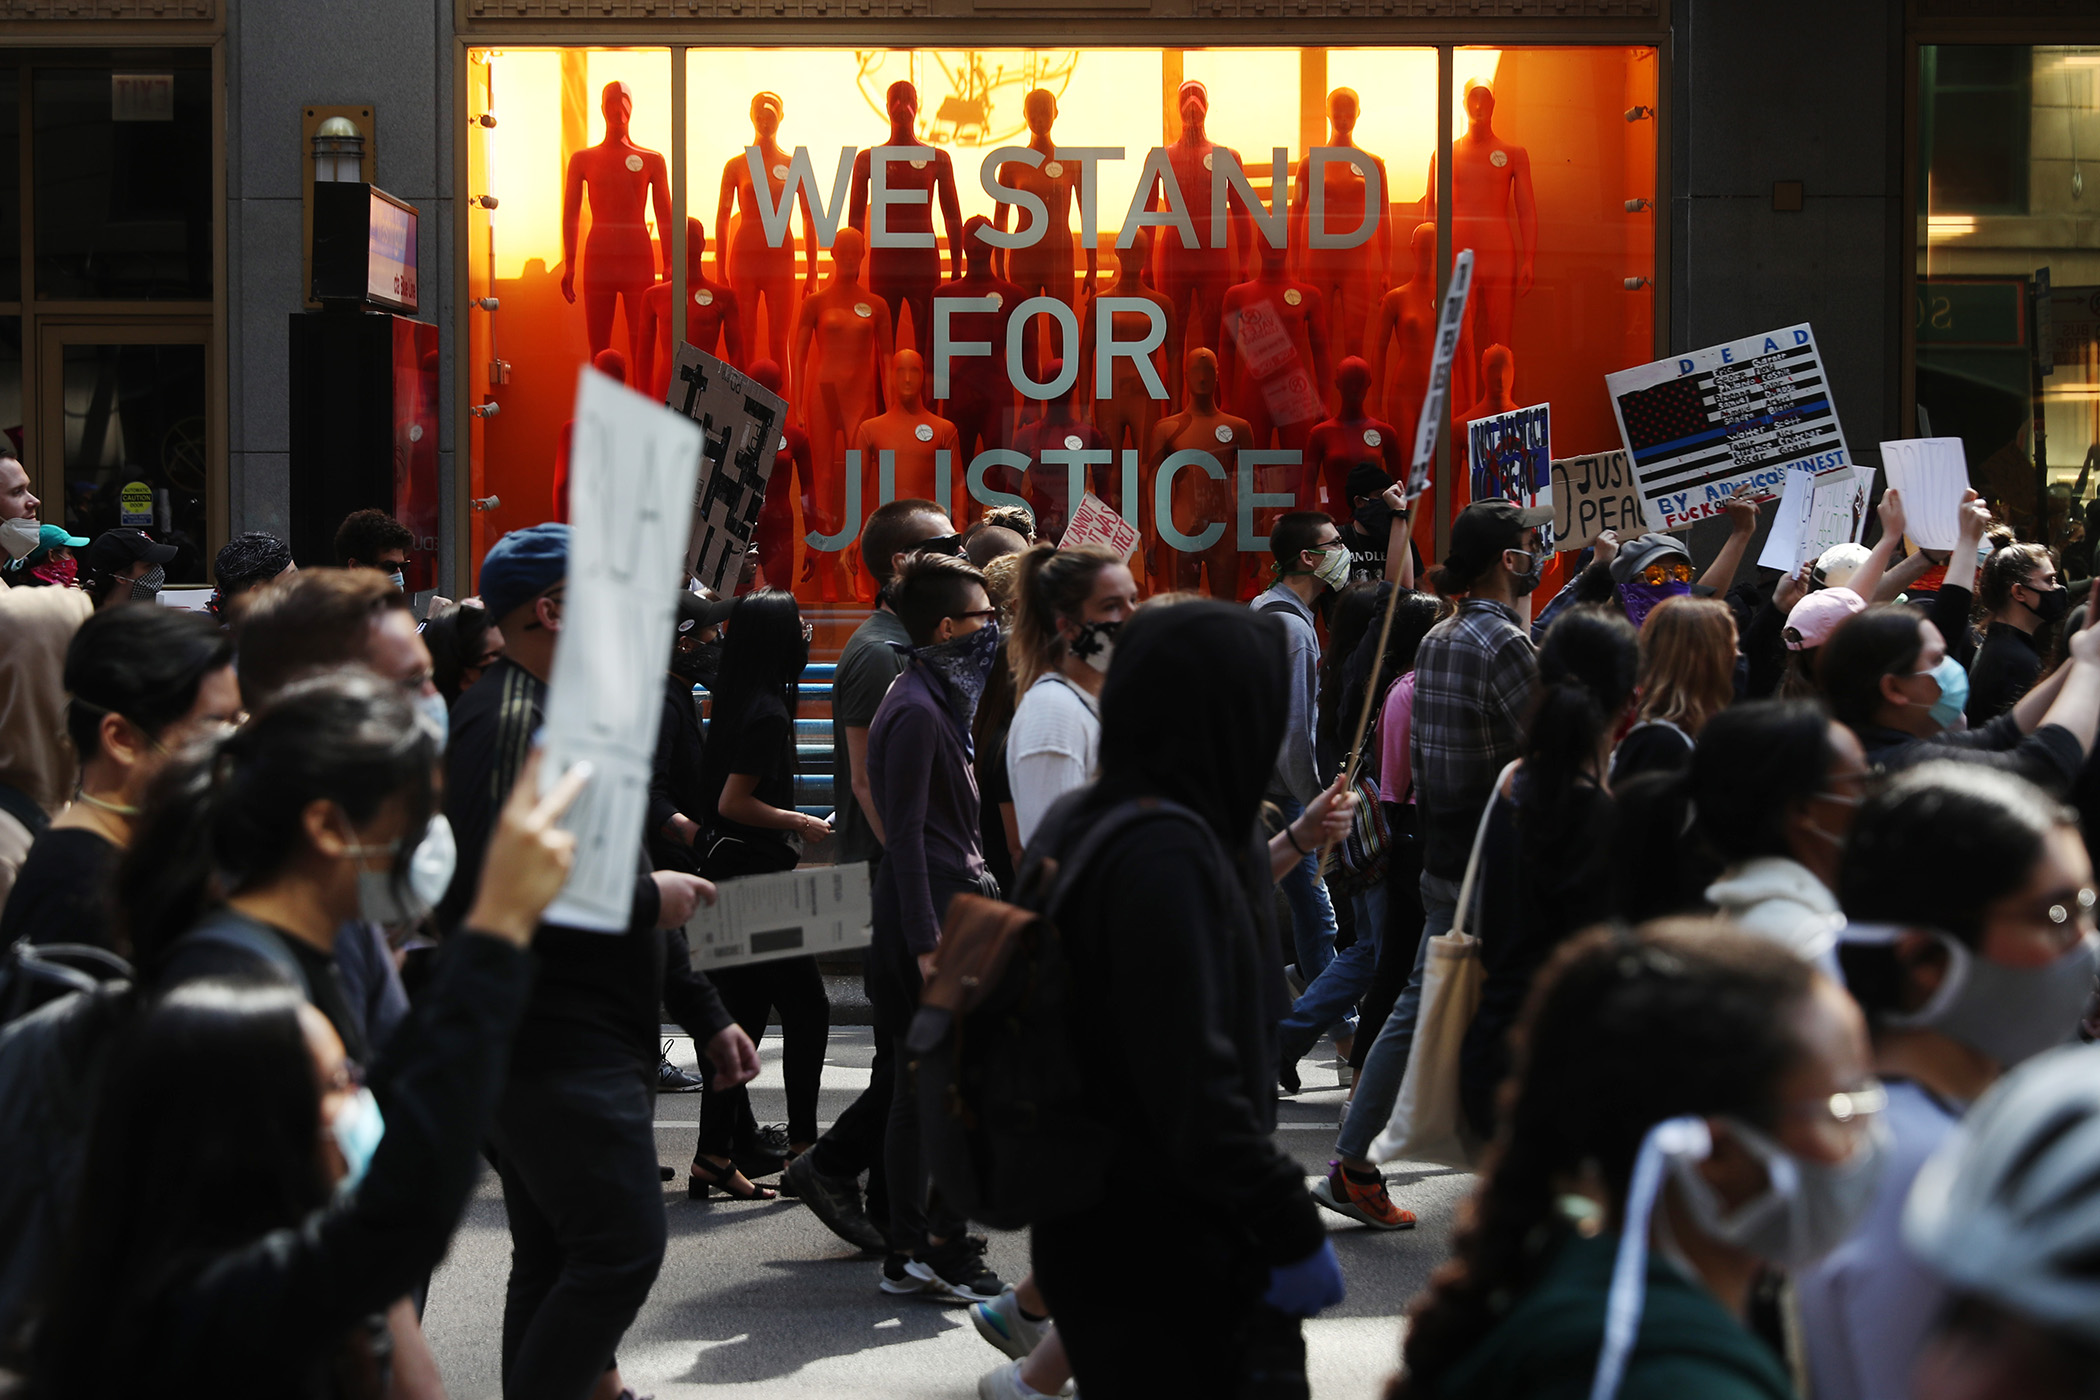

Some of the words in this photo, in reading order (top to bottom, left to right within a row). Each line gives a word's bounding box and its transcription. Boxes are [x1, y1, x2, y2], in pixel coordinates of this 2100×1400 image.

[745, 146, 935, 248] WE
[974, 146, 1381, 249] STAND
[933, 297, 1169, 400] FOR
[1679, 330, 1808, 375] DEAD
[1712, 366, 1733, 377] Eric
[1713, 371, 1748, 386] George
[1718, 396, 1750, 409] Samuel
[1724, 413, 1754, 425] Sandra
[1767, 402, 1795, 415] Bland
[1497, 407, 1549, 455] JUSTICE
[1727, 426, 1765, 440] Walter
[1774, 416, 1801, 430] Scott
[1734, 452, 1766, 465] Oscar
[1779, 441, 1811, 455] Grant
[805, 449, 1303, 551] JUSTICE
[1657, 492, 1687, 515] BY
[1066, 498, 1097, 544] CANNOT
[1093, 506, 1119, 538] WAS
[1665, 503, 1716, 528] FUCK
